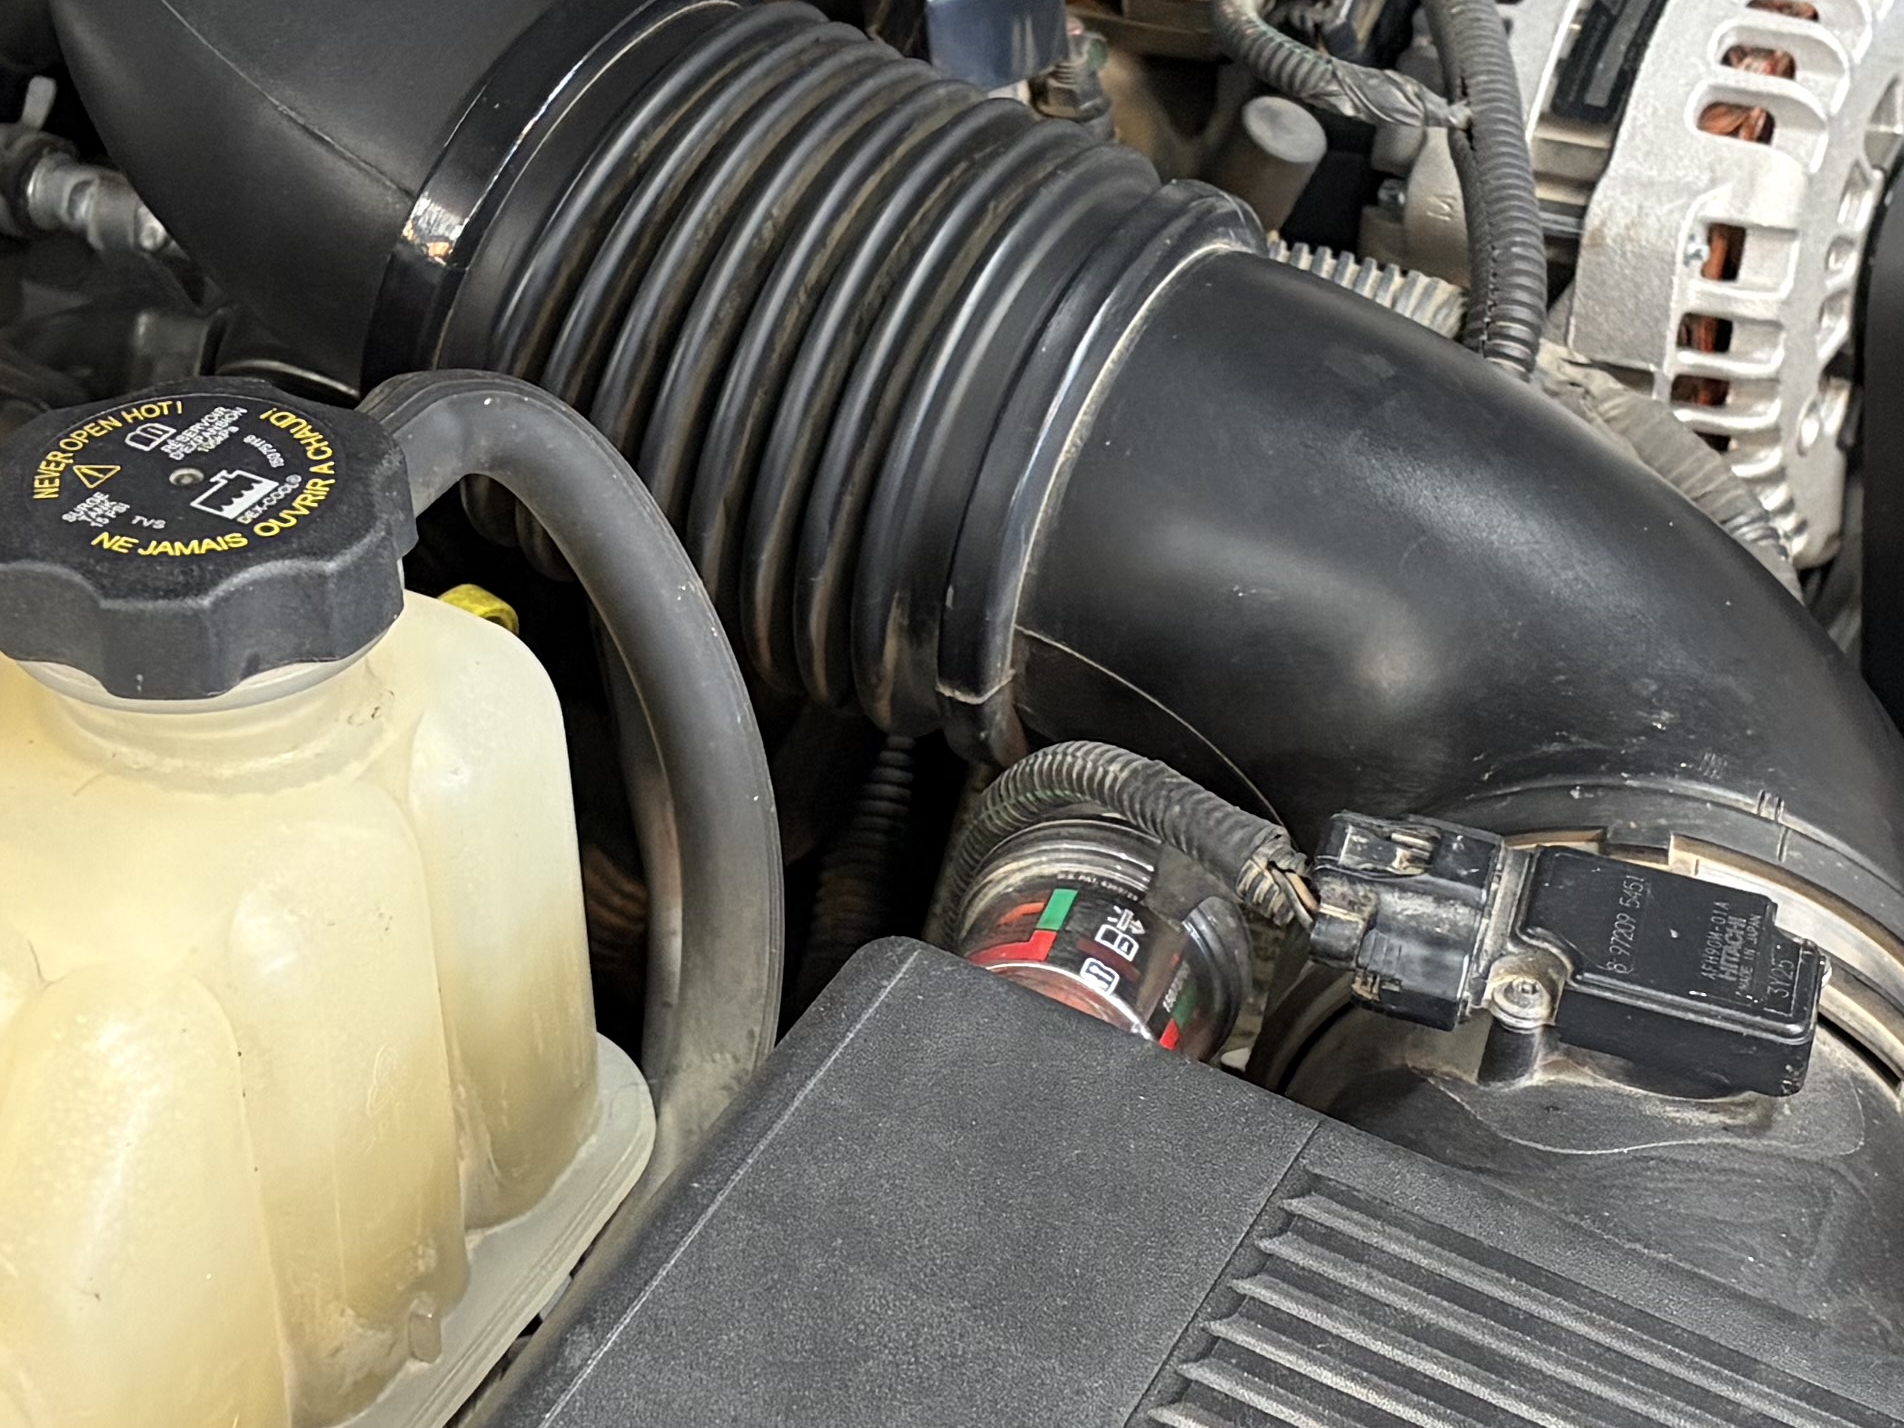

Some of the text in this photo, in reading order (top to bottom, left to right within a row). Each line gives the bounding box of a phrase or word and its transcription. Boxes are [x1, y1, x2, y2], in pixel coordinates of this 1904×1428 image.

[33, 400, 183, 499] NEVER OPEN HOT!
[259, 407, 333, 459] CHAUD!
[81, 499, 117, 522] TANK
[131, 515, 165, 529] TVS
[253, 478, 335, 537] OUVRIR
[91, 531, 139, 553] NE
[137, 533, 248, 556] JAMAIS
[1609, 875, 1645, 957] 97209 5451
[1720, 915, 1746, 982] HITACHI
[1736, 966, 1754, 996] MADE
[1747, 914, 1762, 945] JAPAN
